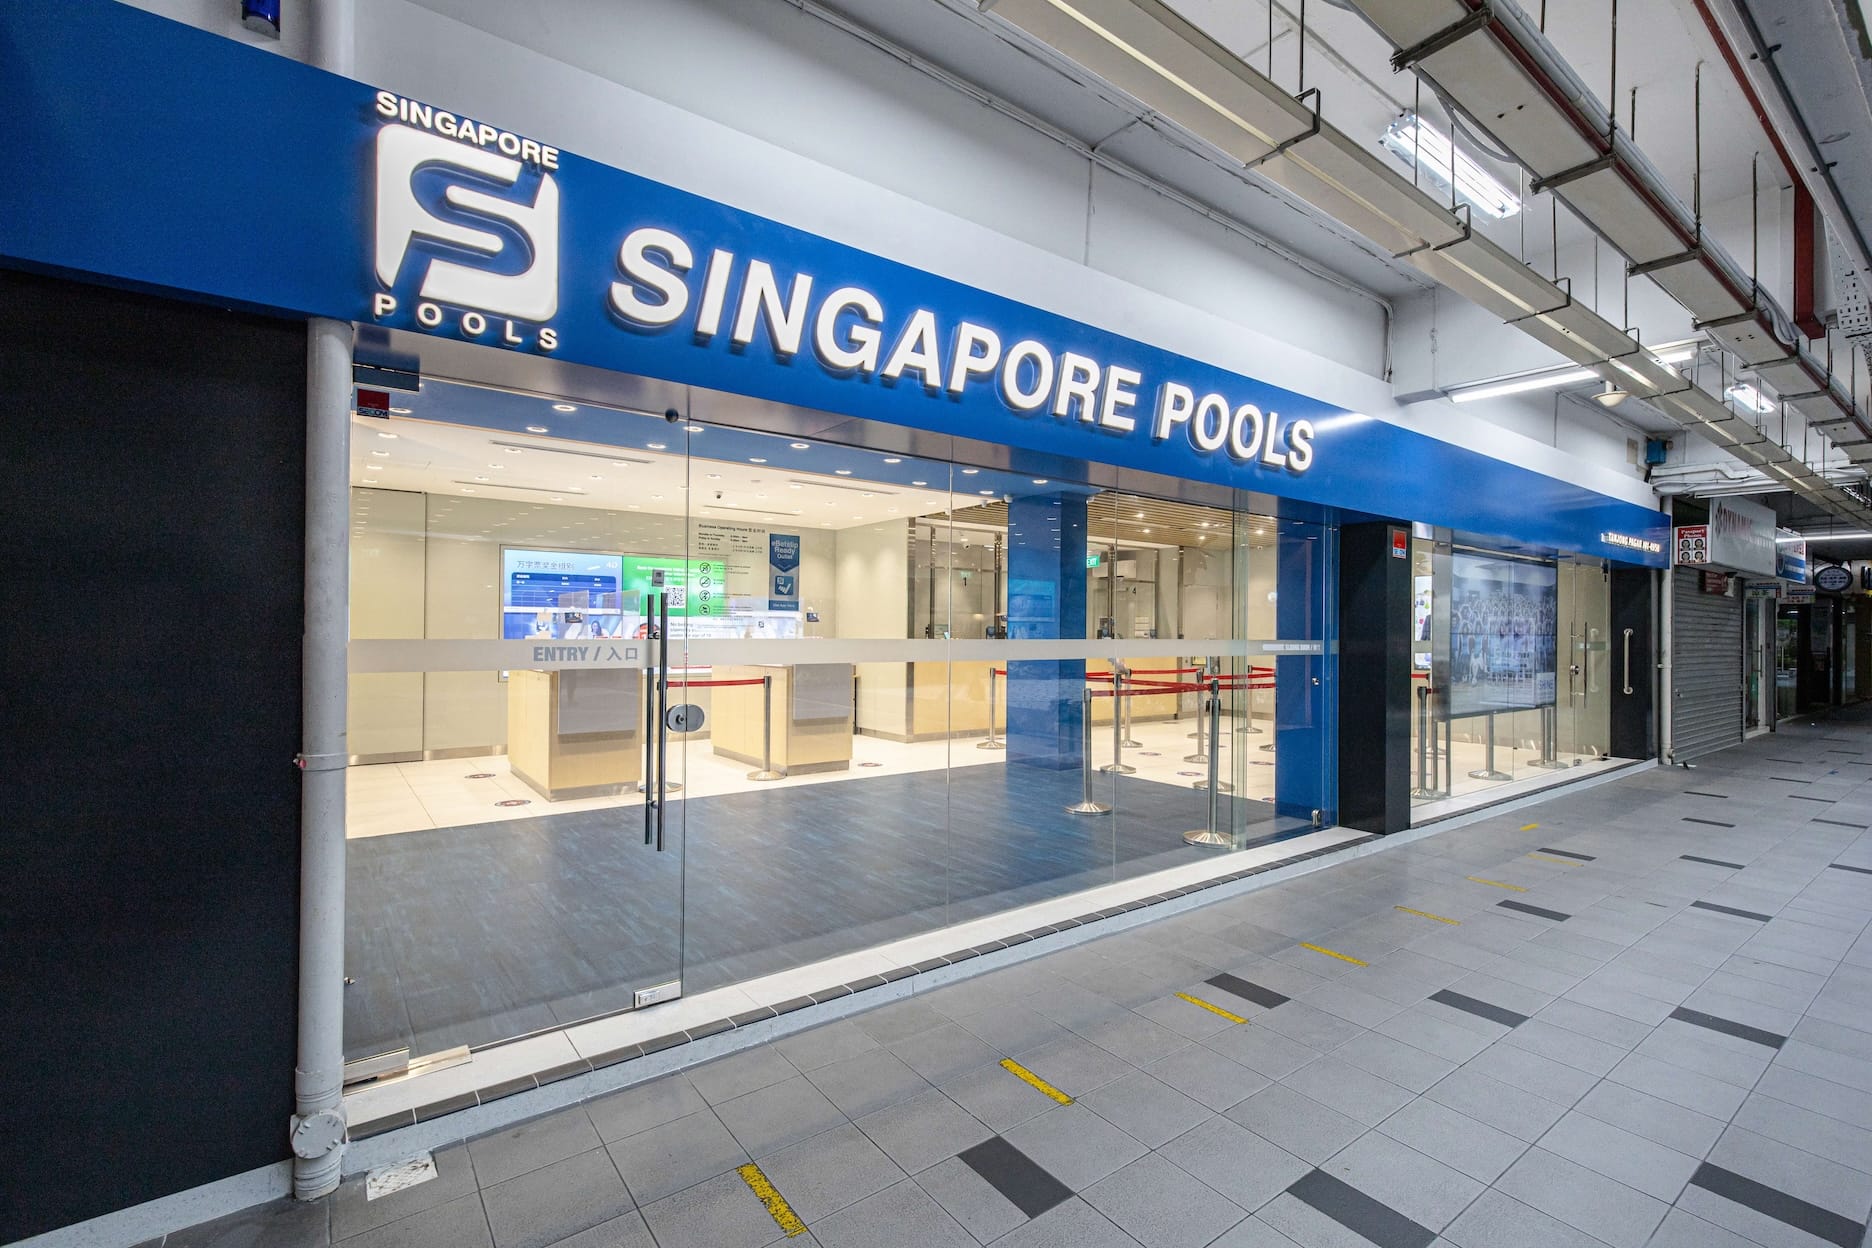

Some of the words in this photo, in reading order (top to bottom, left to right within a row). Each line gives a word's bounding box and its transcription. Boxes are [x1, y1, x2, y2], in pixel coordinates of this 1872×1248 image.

[375, 90, 560, 171] SINGAPORE
[374, 292, 559, 351] POOLS
[611, 227, 1141, 432] SINGAPORE
[1155, 382, 1315, 473] POOLS
[775, 547, 795, 555] Ready
[533, 646, 588, 662] ENTRY
[593, 646, 602, 661] /
[606, 646, 638, 660] 入口
